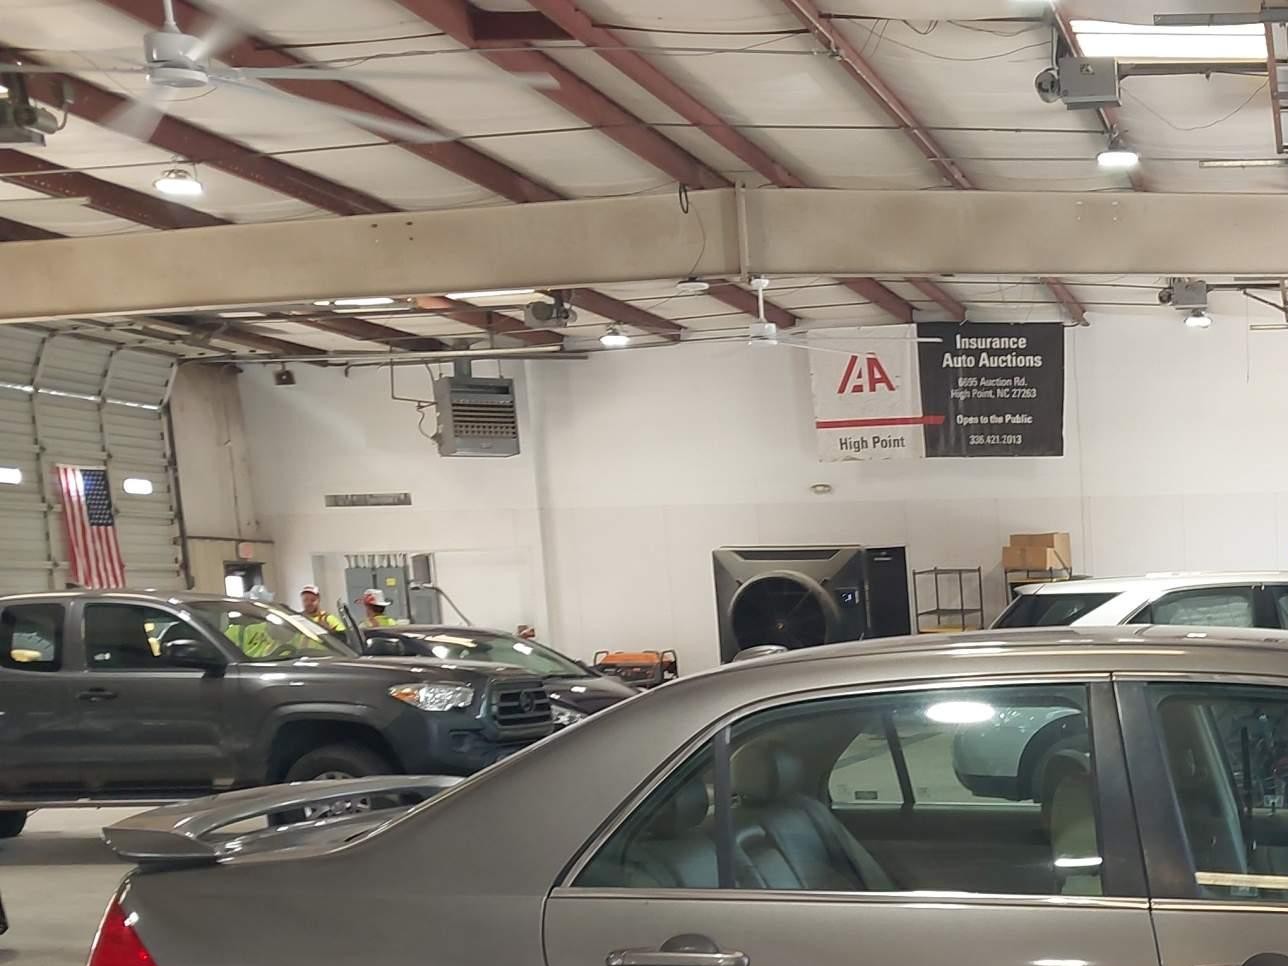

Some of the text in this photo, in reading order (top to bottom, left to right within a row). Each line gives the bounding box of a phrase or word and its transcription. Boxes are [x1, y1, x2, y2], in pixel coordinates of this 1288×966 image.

[955, 334, 1027, 349] Insurance
[942, 352, 1043, 368] Auto Auctions
[980, 376, 1013, 387] Auction
[1013, 376, 1028, 387] Rd.
[950, 388, 971, 401] High
[997, 388, 1010, 398] NC
[956, 414, 1033, 426] Open to the Public
[840, 434, 906, 453] High Point
